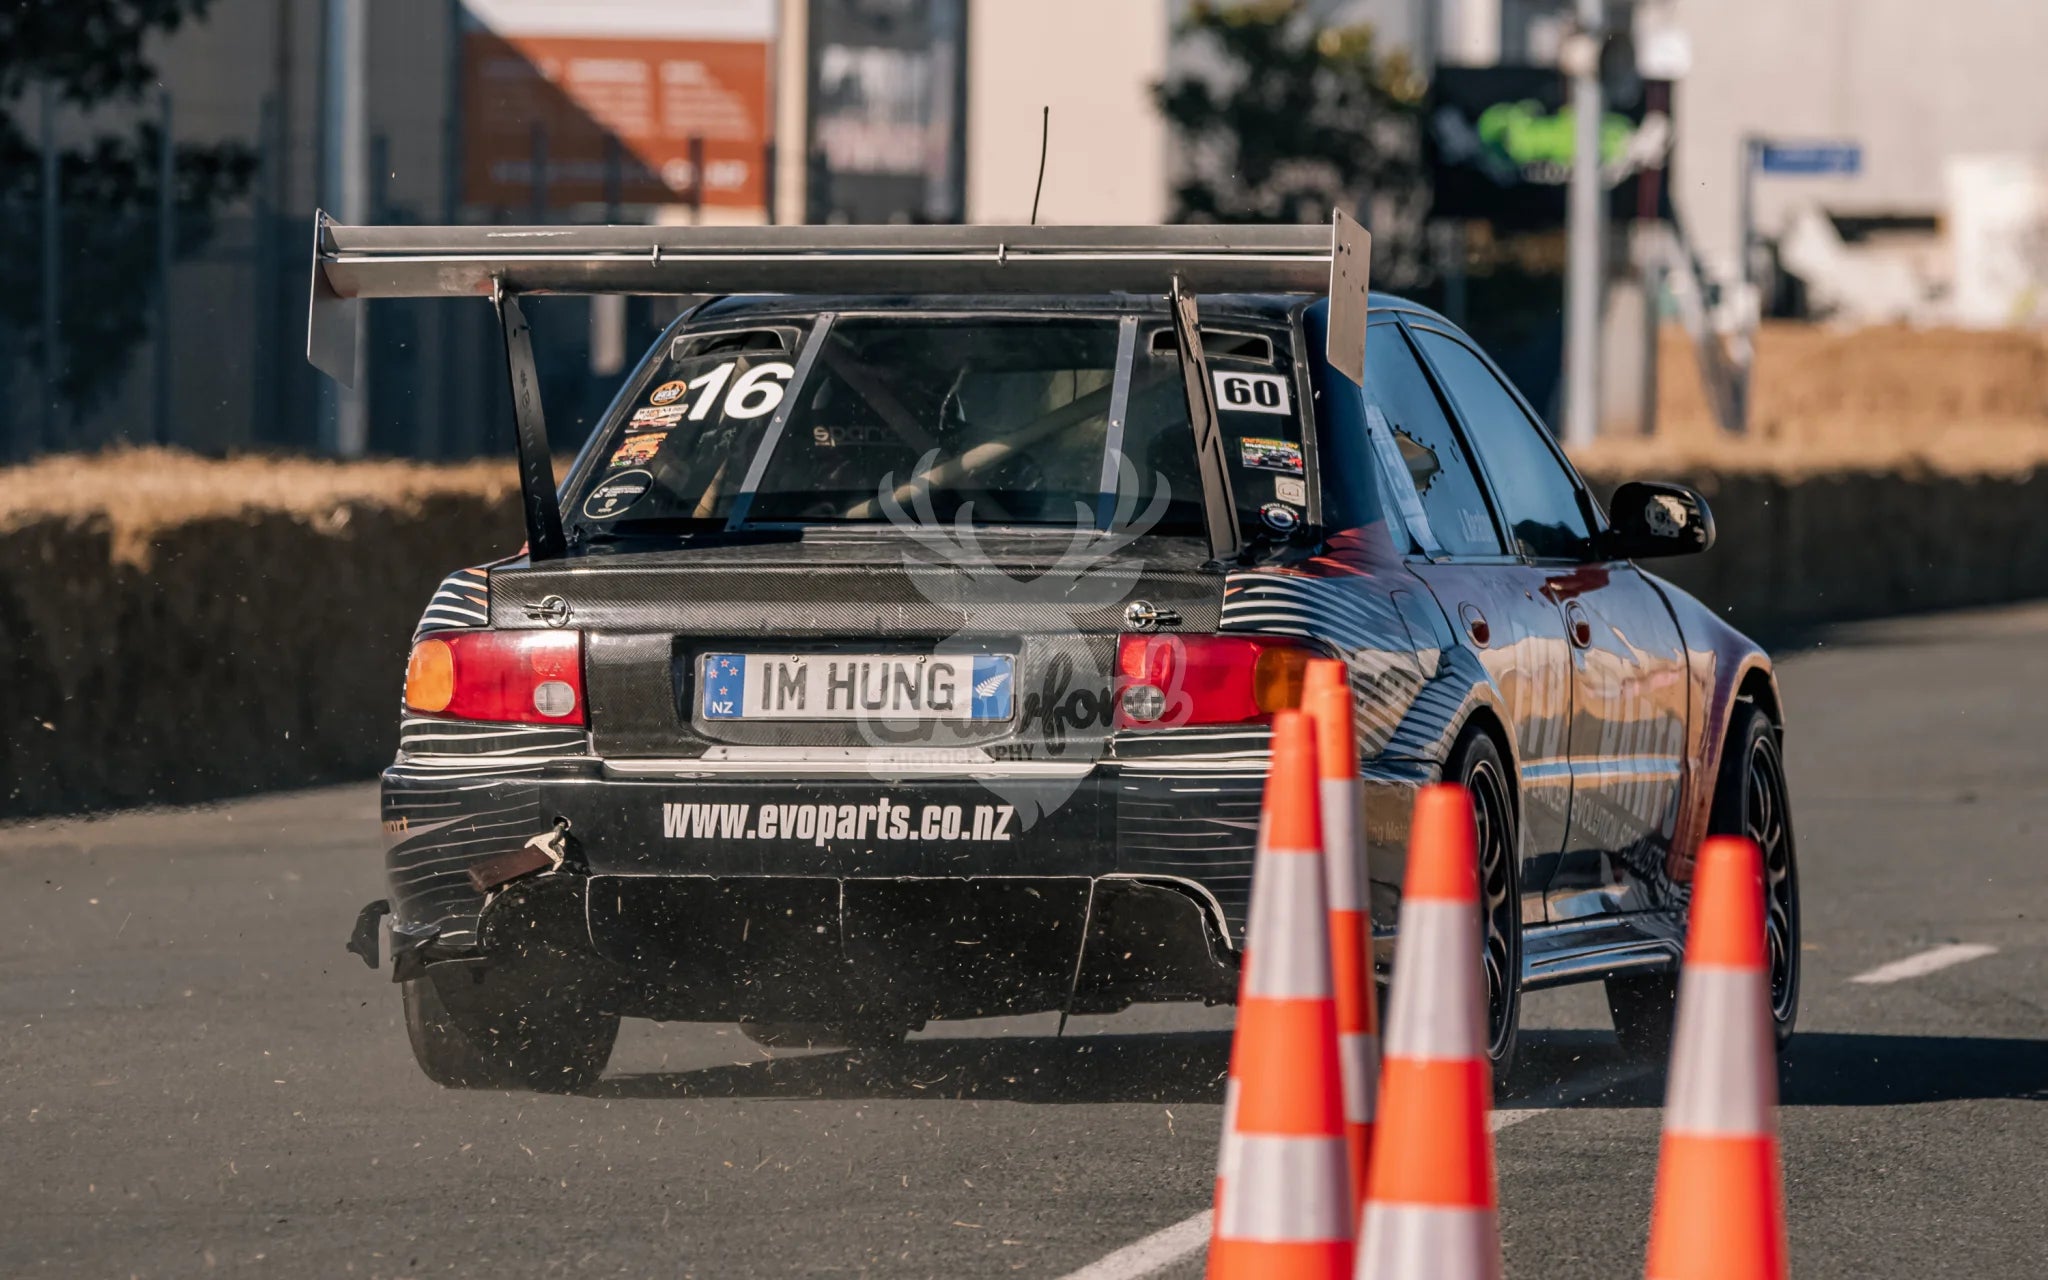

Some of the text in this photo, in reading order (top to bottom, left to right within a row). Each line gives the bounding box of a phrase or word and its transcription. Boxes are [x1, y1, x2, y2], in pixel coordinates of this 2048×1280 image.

[688, 362, 795, 421] 16
[1223, 378, 1280, 407] 60
[711, 701, 735, 715] NZ
[761, 661, 955, 712] IM HUNG
[663, 797, 1014, 846] www.evoparts.co.nz
